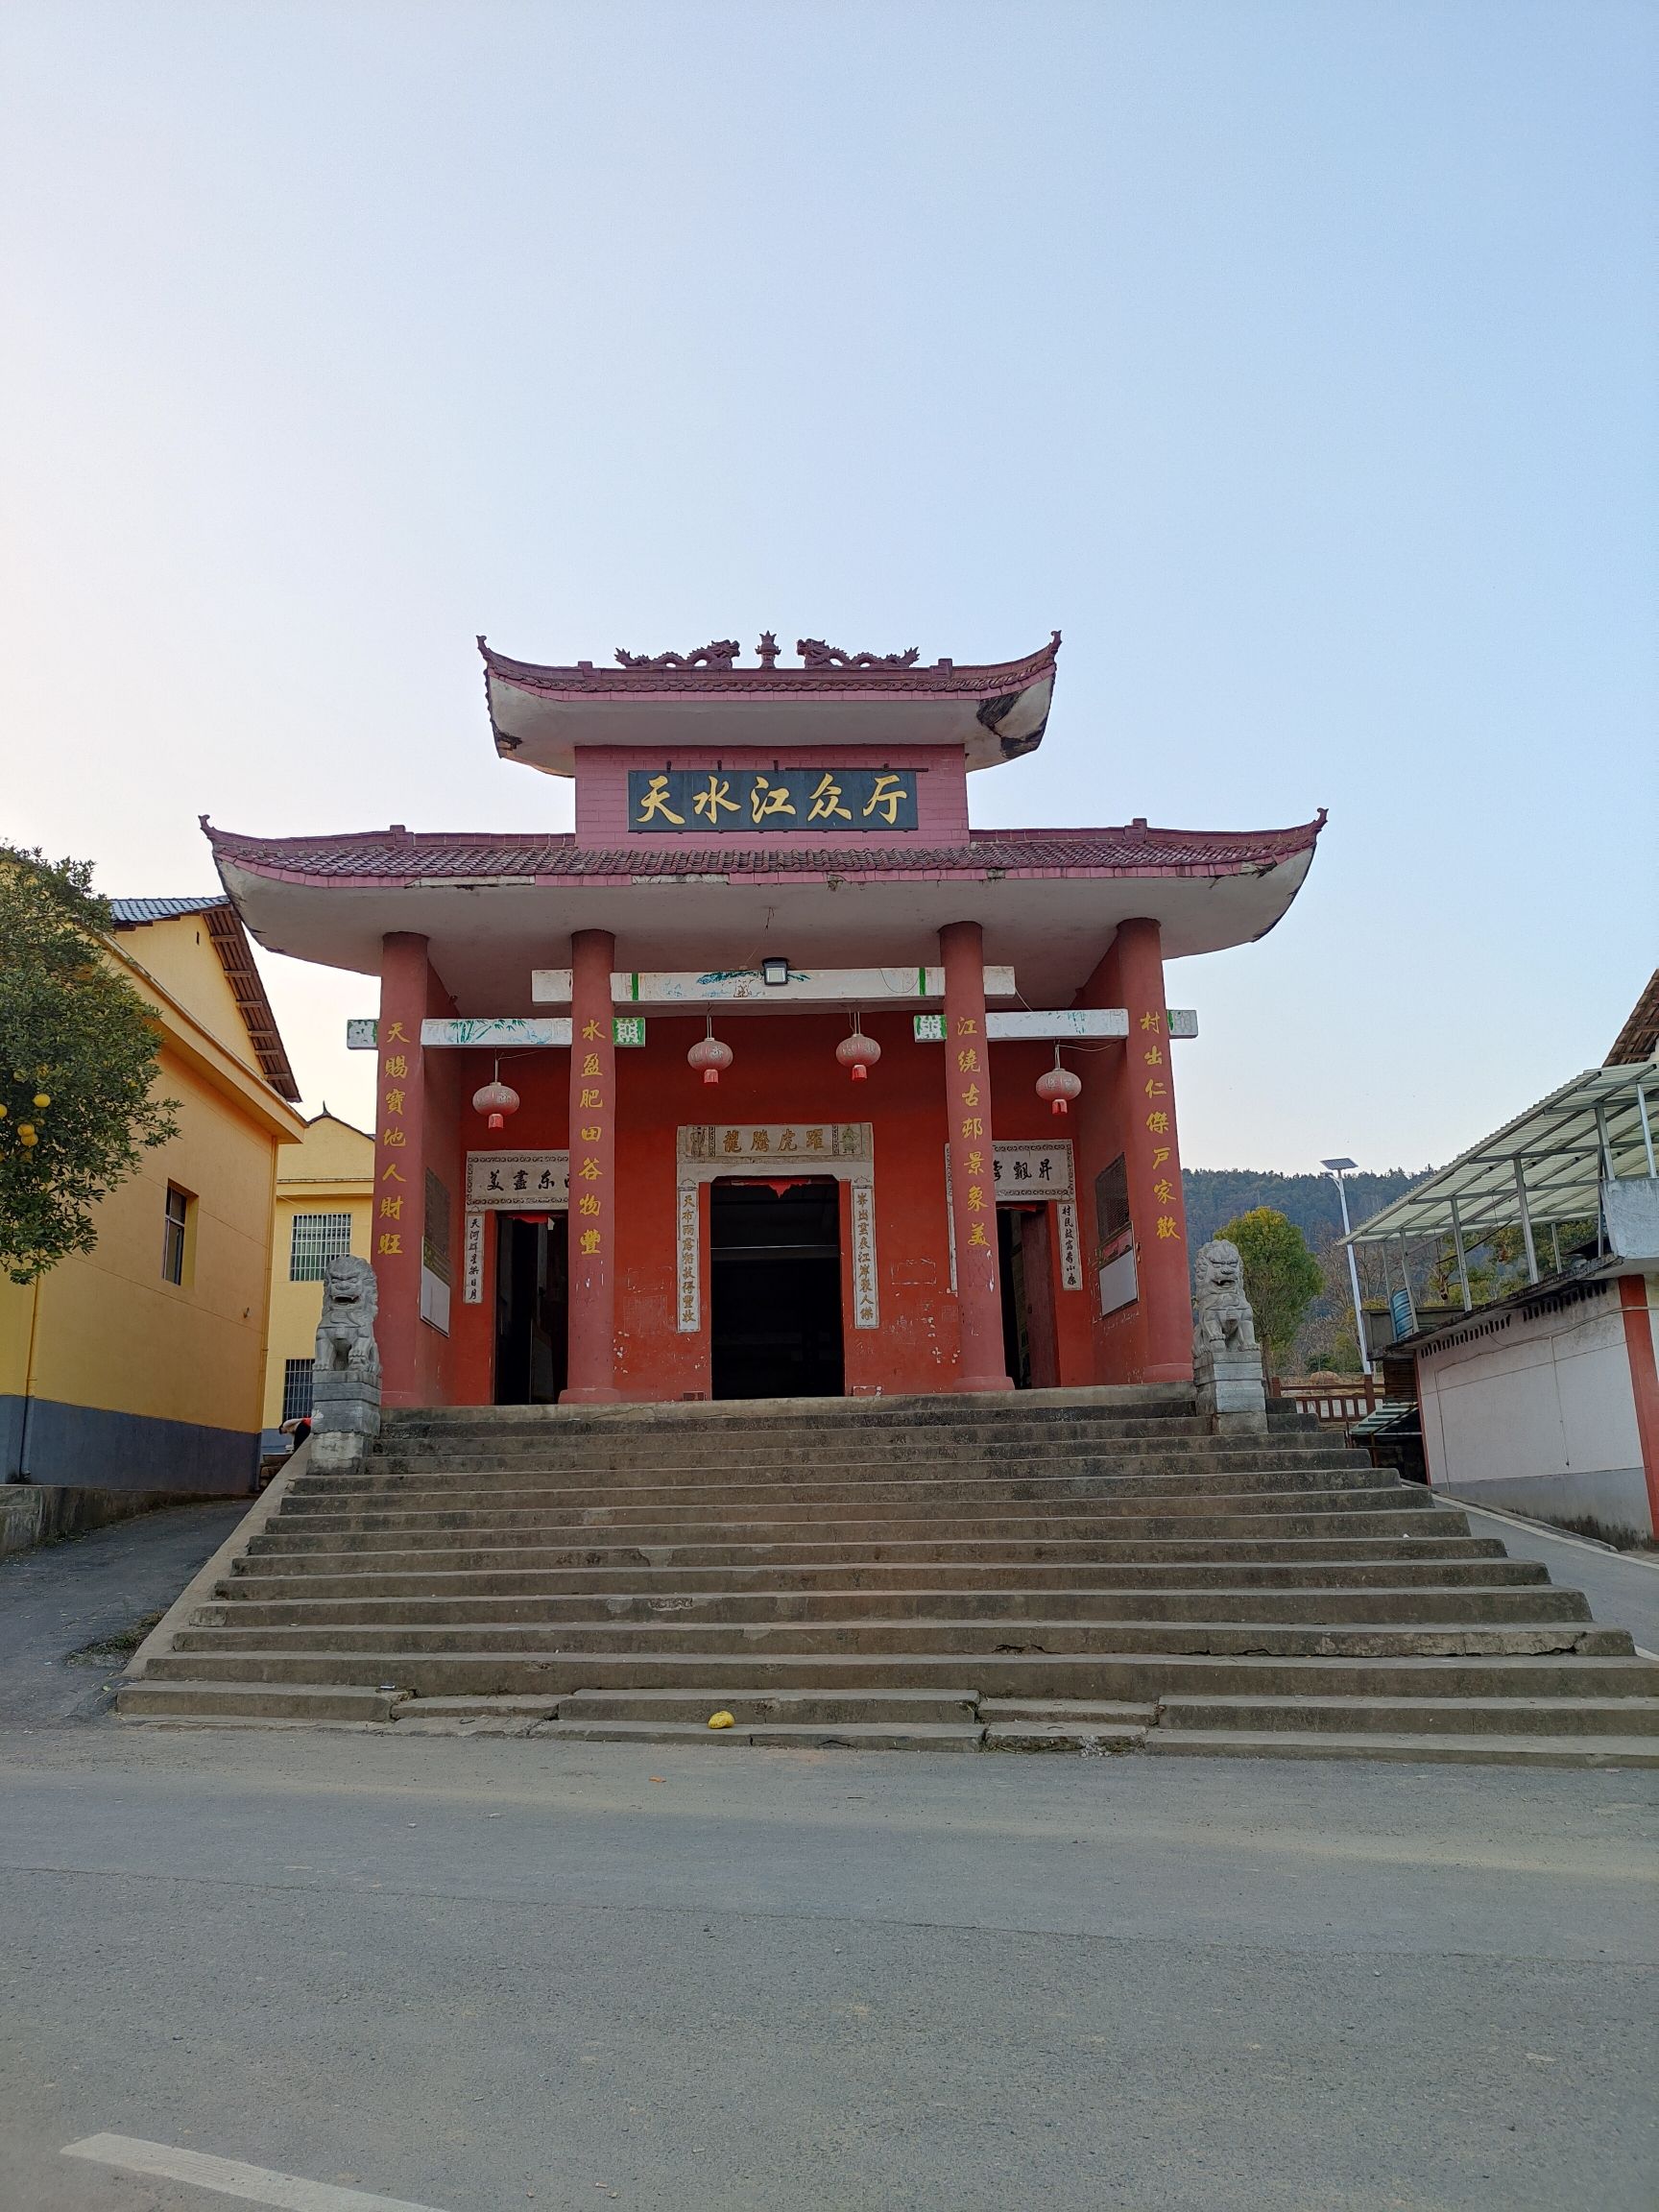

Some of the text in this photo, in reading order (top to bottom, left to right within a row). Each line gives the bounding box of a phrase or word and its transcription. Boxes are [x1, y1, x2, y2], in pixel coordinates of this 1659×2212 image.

[636, 773, 907, 824] 天水江众厅
[379, 1022, 411, 1254] 天賜寶地人財旺
